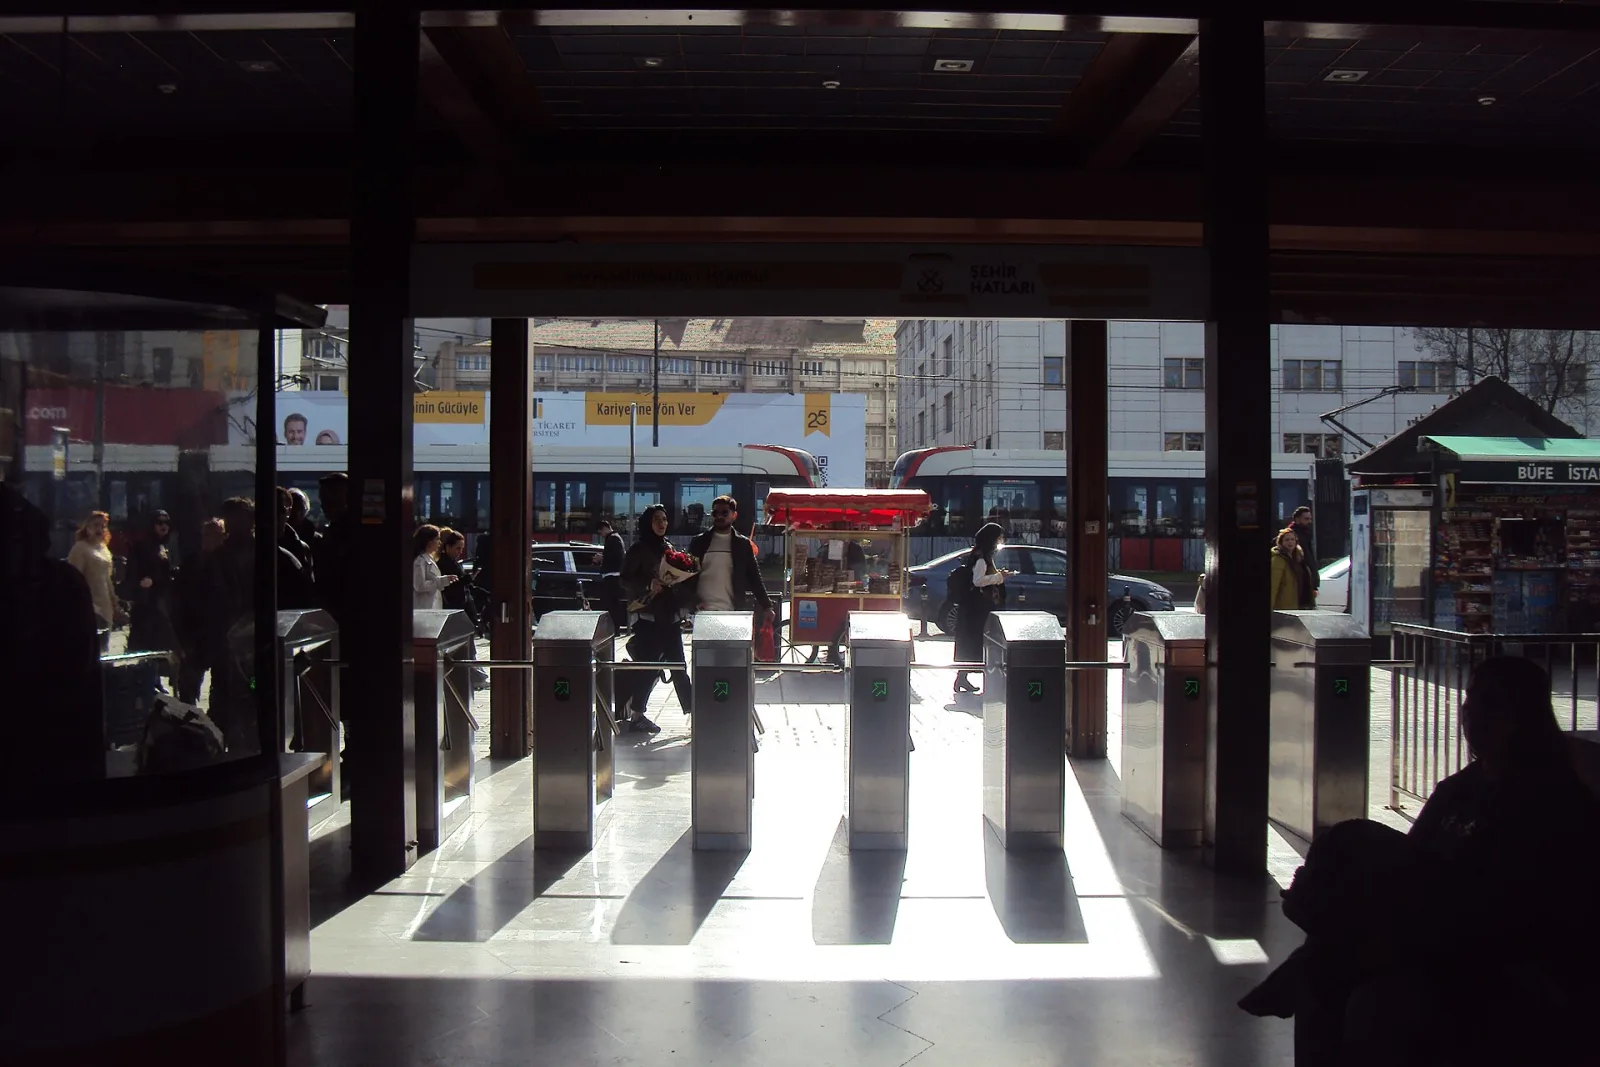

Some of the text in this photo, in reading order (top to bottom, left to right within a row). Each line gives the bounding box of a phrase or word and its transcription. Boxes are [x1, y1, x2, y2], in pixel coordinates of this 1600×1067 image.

[970, 261, 1017, 280] ŞEHİR
[970, 280, 1035, 295] HATLARI
[438, 401, 478, 416] Gücüyle
[597, 402, 652, 417] Kariyeine
[677, 402, 696, 415] Ver
[538, 420, 576, 430] TİCARET
[807, 409, 827, 428] 25
[1517, 463, 1600, 480] BÜFE İSTA
